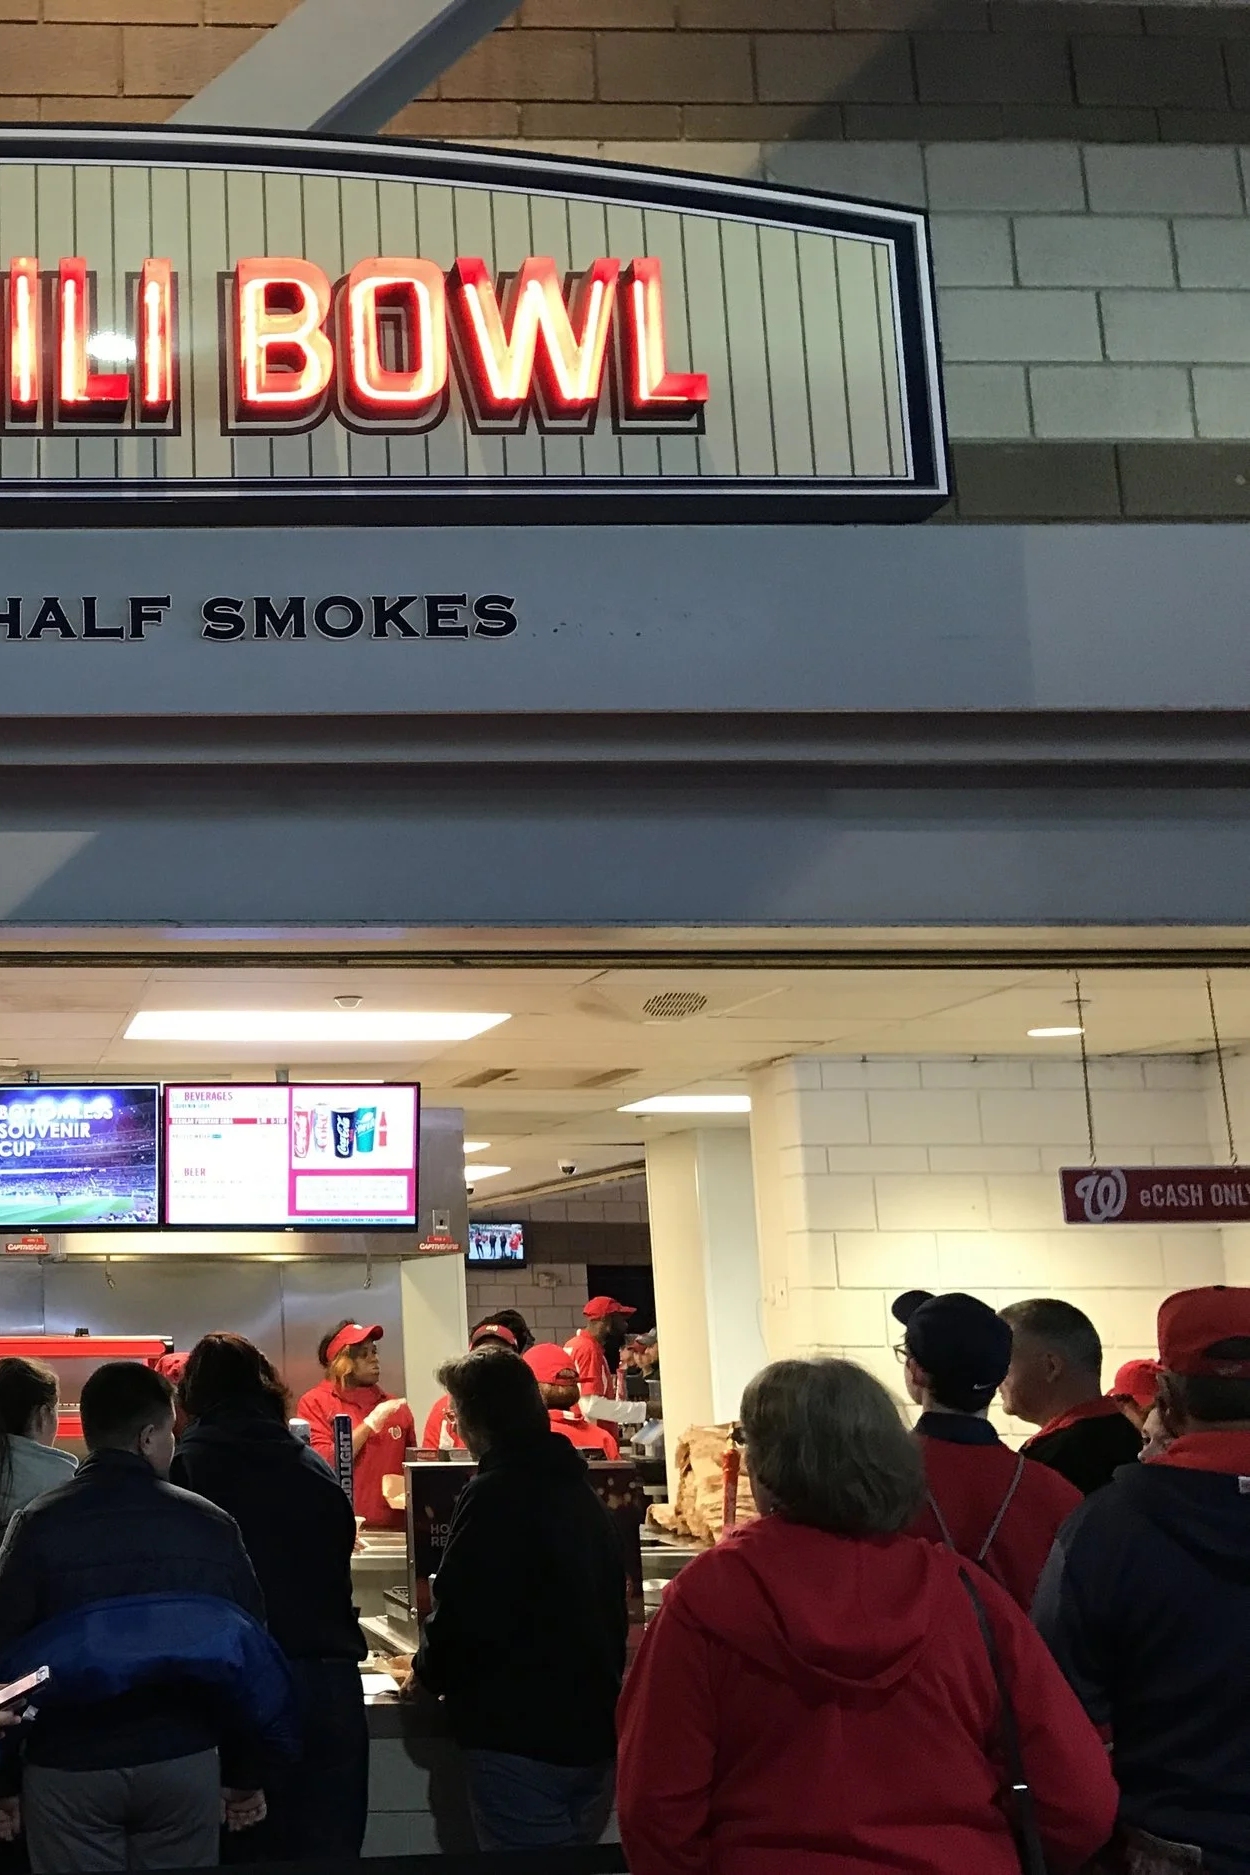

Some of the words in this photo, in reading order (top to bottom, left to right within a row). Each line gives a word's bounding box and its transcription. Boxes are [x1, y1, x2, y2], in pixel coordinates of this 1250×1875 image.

[234, 256, 710, 412] BOWL
[200, 593, 520, 642] SMOKES
[184, 1091, 233, 1101] BEVERAGES
[184, 1167, 206, 1177] BEER
[1139, 1183, 1203, 1207] eCASH
[339, 1431, 352, 1476] LIGHT
